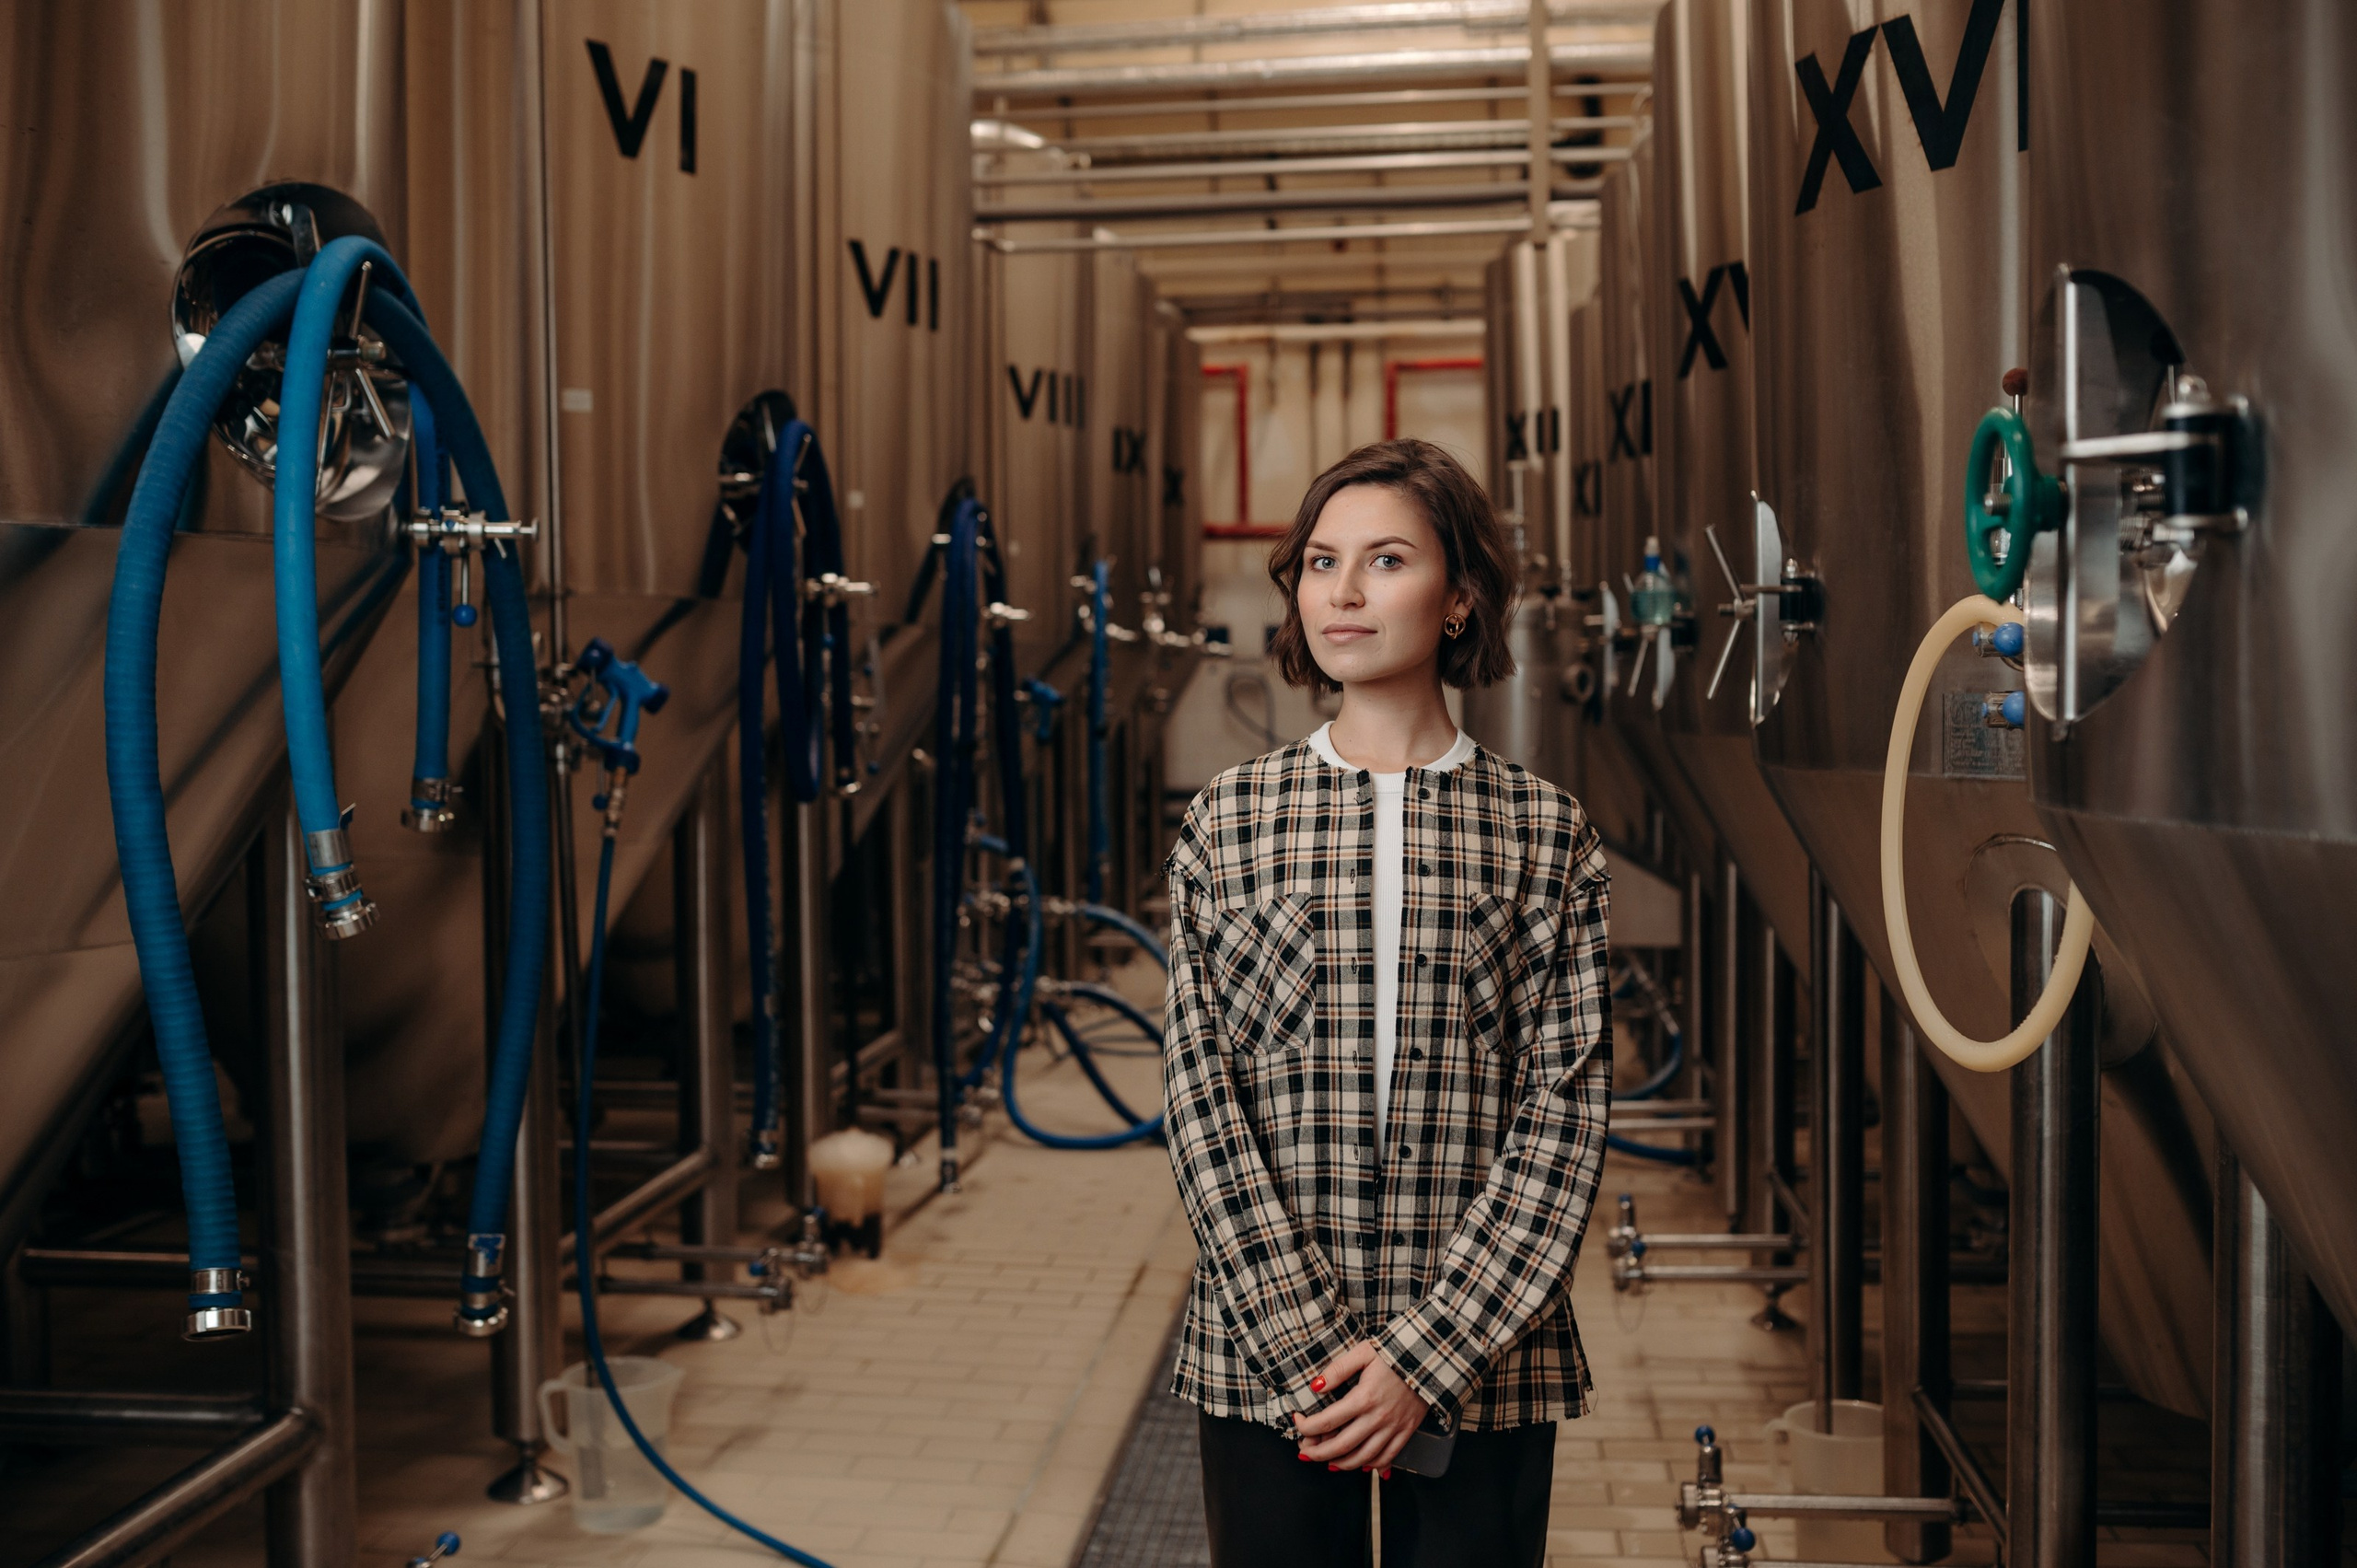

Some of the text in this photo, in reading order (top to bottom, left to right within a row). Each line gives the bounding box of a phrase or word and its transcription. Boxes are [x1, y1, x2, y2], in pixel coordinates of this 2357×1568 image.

[586, 38, 697, 176] VI
[848, 238, 938, 331] VII
[1008, 364, 1085, 428] VIII
[1113, 427, 1147, 475] IX
[1506, 405, 1560, 459] XII
